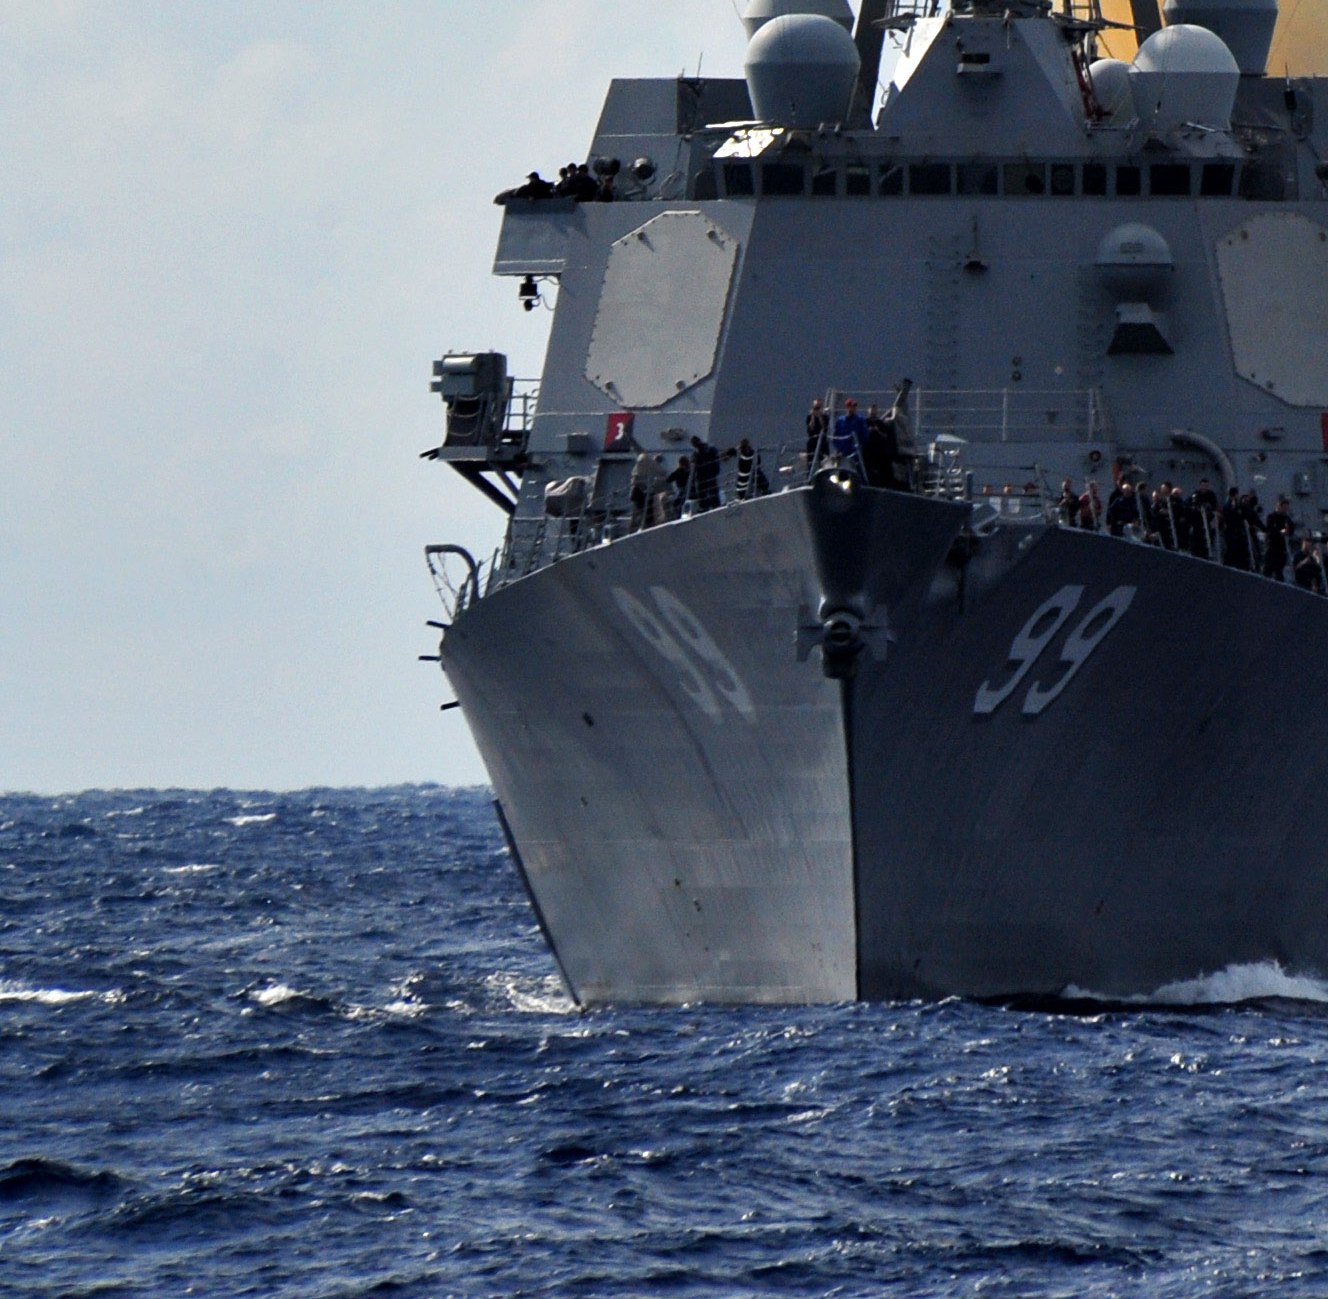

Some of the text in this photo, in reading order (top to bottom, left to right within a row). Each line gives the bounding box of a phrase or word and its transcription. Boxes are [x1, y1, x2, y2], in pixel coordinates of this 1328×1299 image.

[614, 422, 625, 440] 3
[610, 585, 757, 724] 99
[973, 584, 1138, 714] 99
